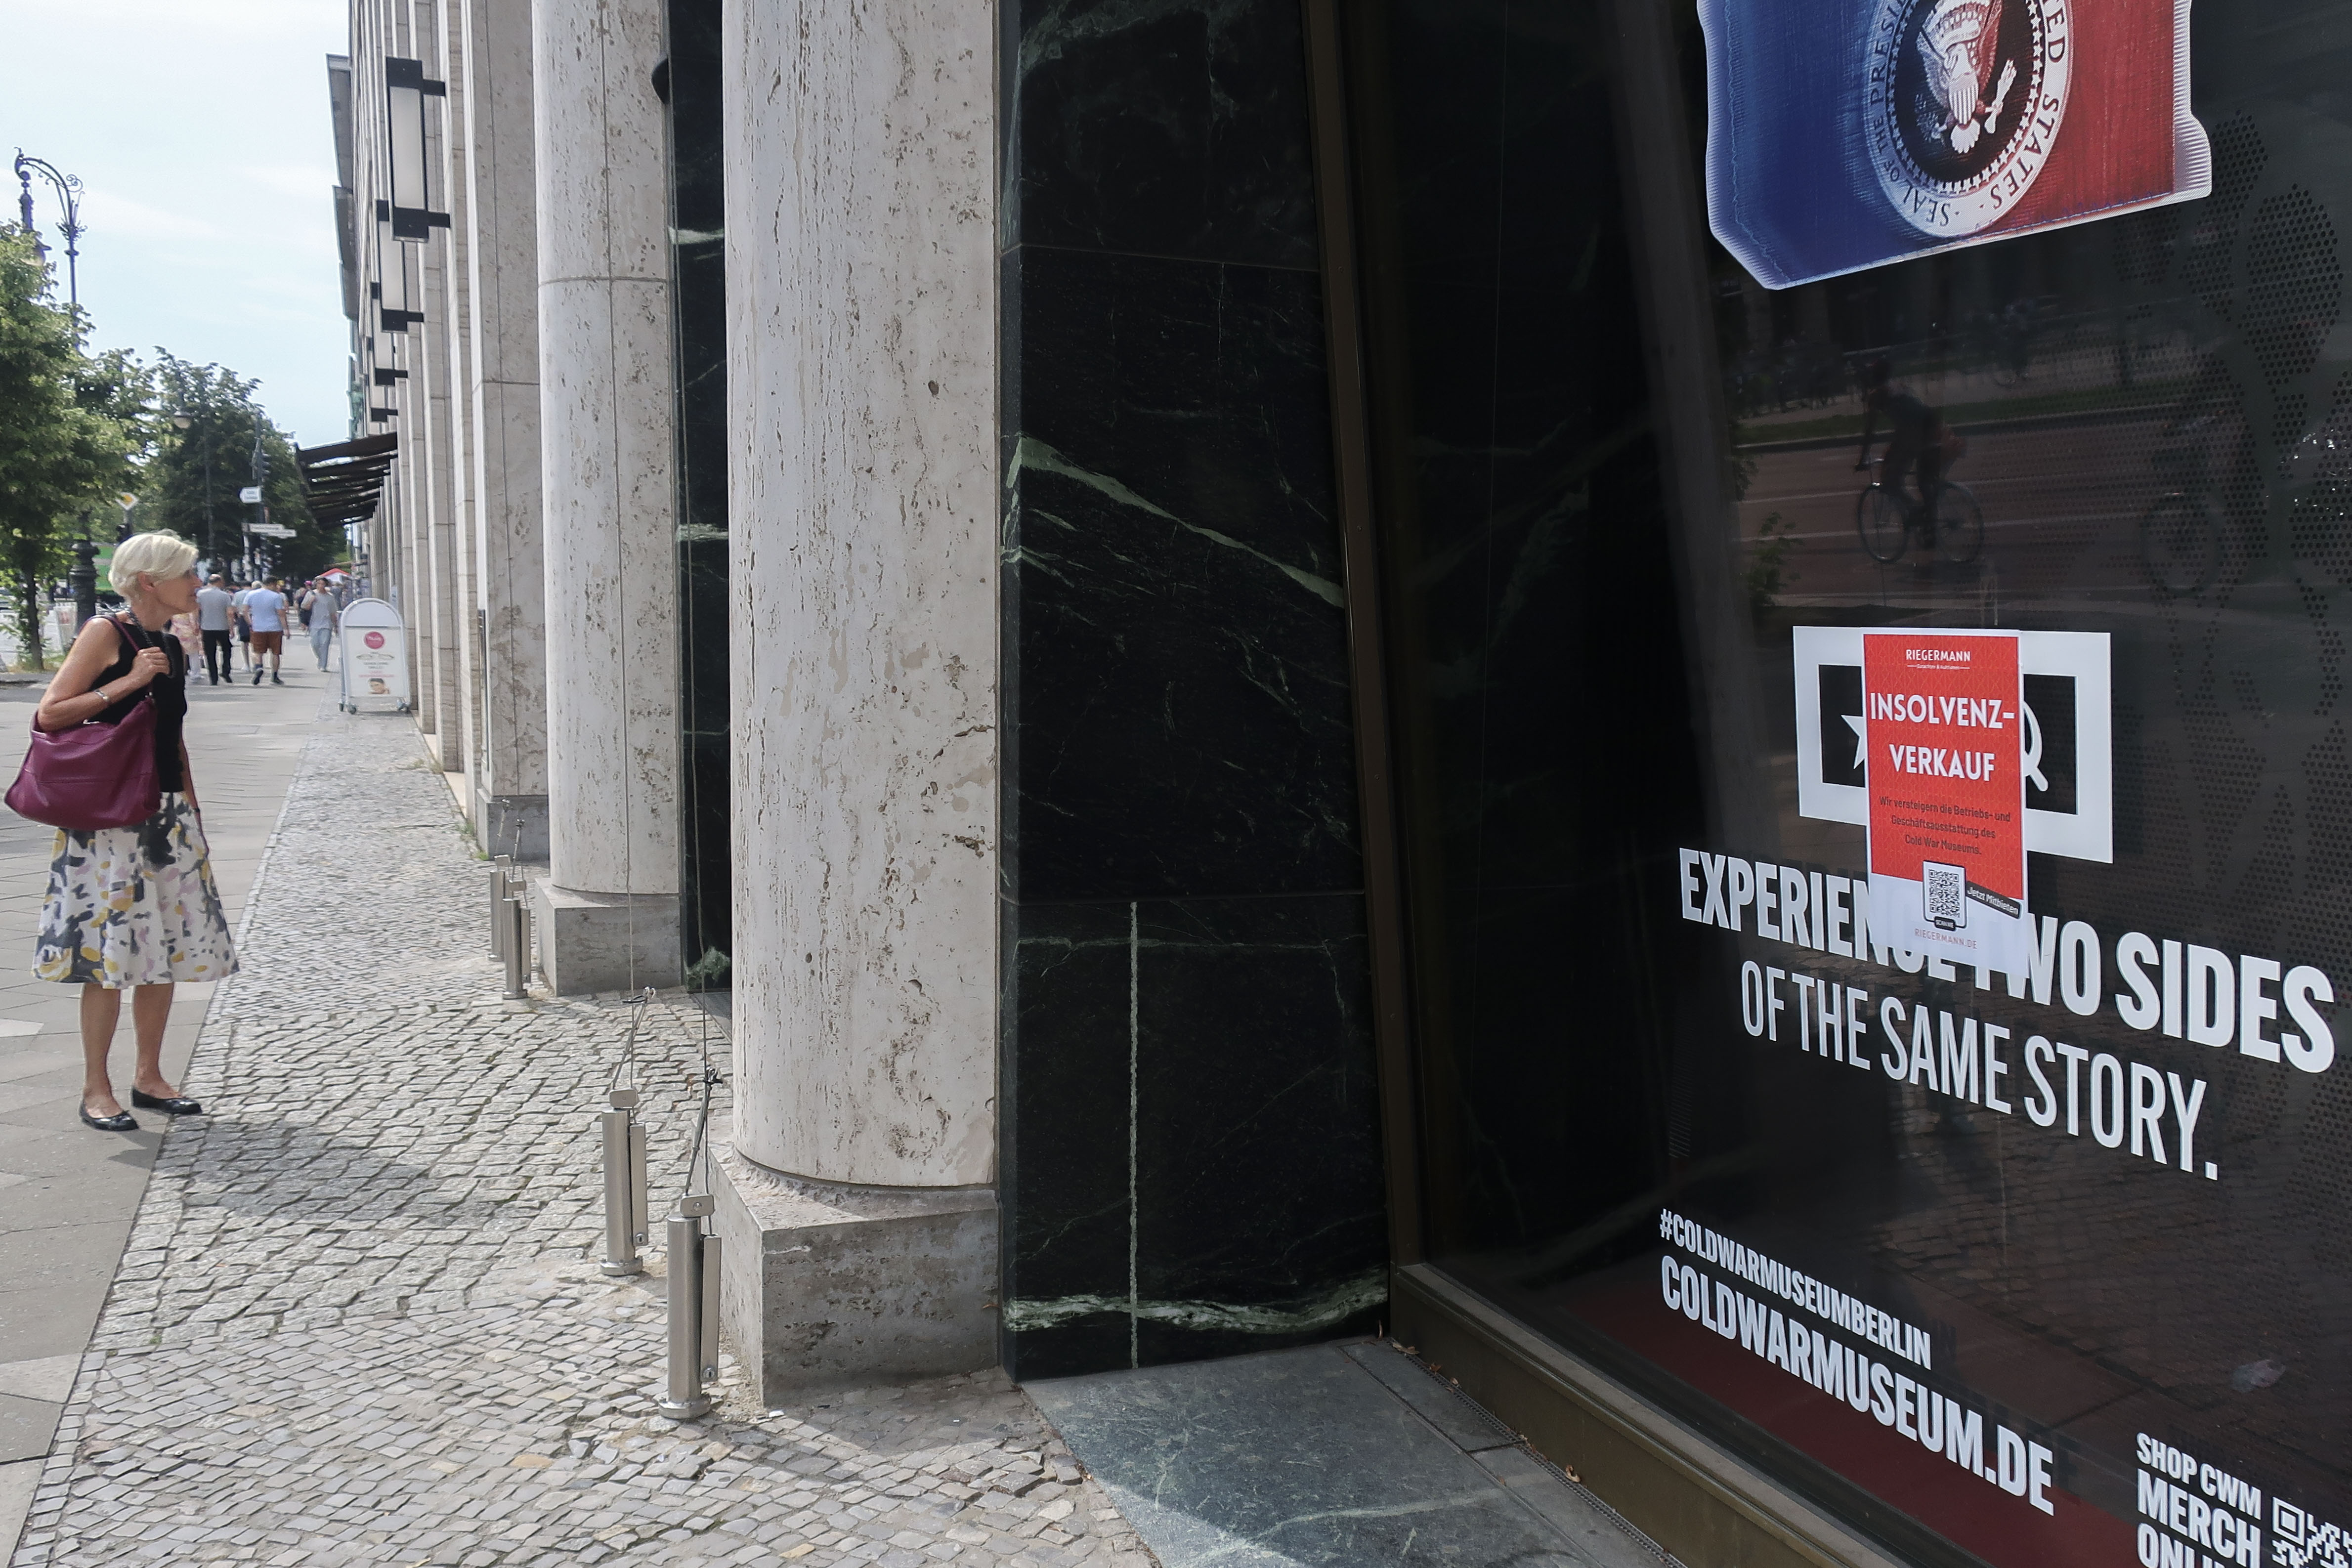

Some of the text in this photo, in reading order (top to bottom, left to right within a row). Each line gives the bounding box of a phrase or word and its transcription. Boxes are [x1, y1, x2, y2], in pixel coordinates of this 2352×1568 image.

[1870, 0, 1951, 226] SEAL OF THE PRESI
[1990, 94, 2059, 209] STATES
[1906, 649, 1970, 662] RIEGERMANN
[1871, 692, 2015, 729] INSOLVENZ-
[1889, 744, 1995, 781] VERKAUF
[1879, 796, 2010, 822] Wir versteigern die Betriebs- und
[1891, 815, 1996, 839] Geschäftsausstattung des
[1905, 834, 1982, 855] Cold War Museums.
[1967, 887, 2019, 915] Jetzt Mitbieten
[1679, 848, 2335, 1073] EXPERIEN WO SIDES
[1915, 928, 1977, 949] RIEGERMANN.DE
[1741, 960, 2218, 1181] OF THE SAME STORY.
[1660, 1208, 1931, 1370] #COLDWARMUSEUMBERLIN
[1662, 1255, 2054, 1516] COLDWARMUSEUM.DE
[2136, 1432, 2262, 1520] SHOP CWM
[2138, 1468, 2261, 1568] MERCH
